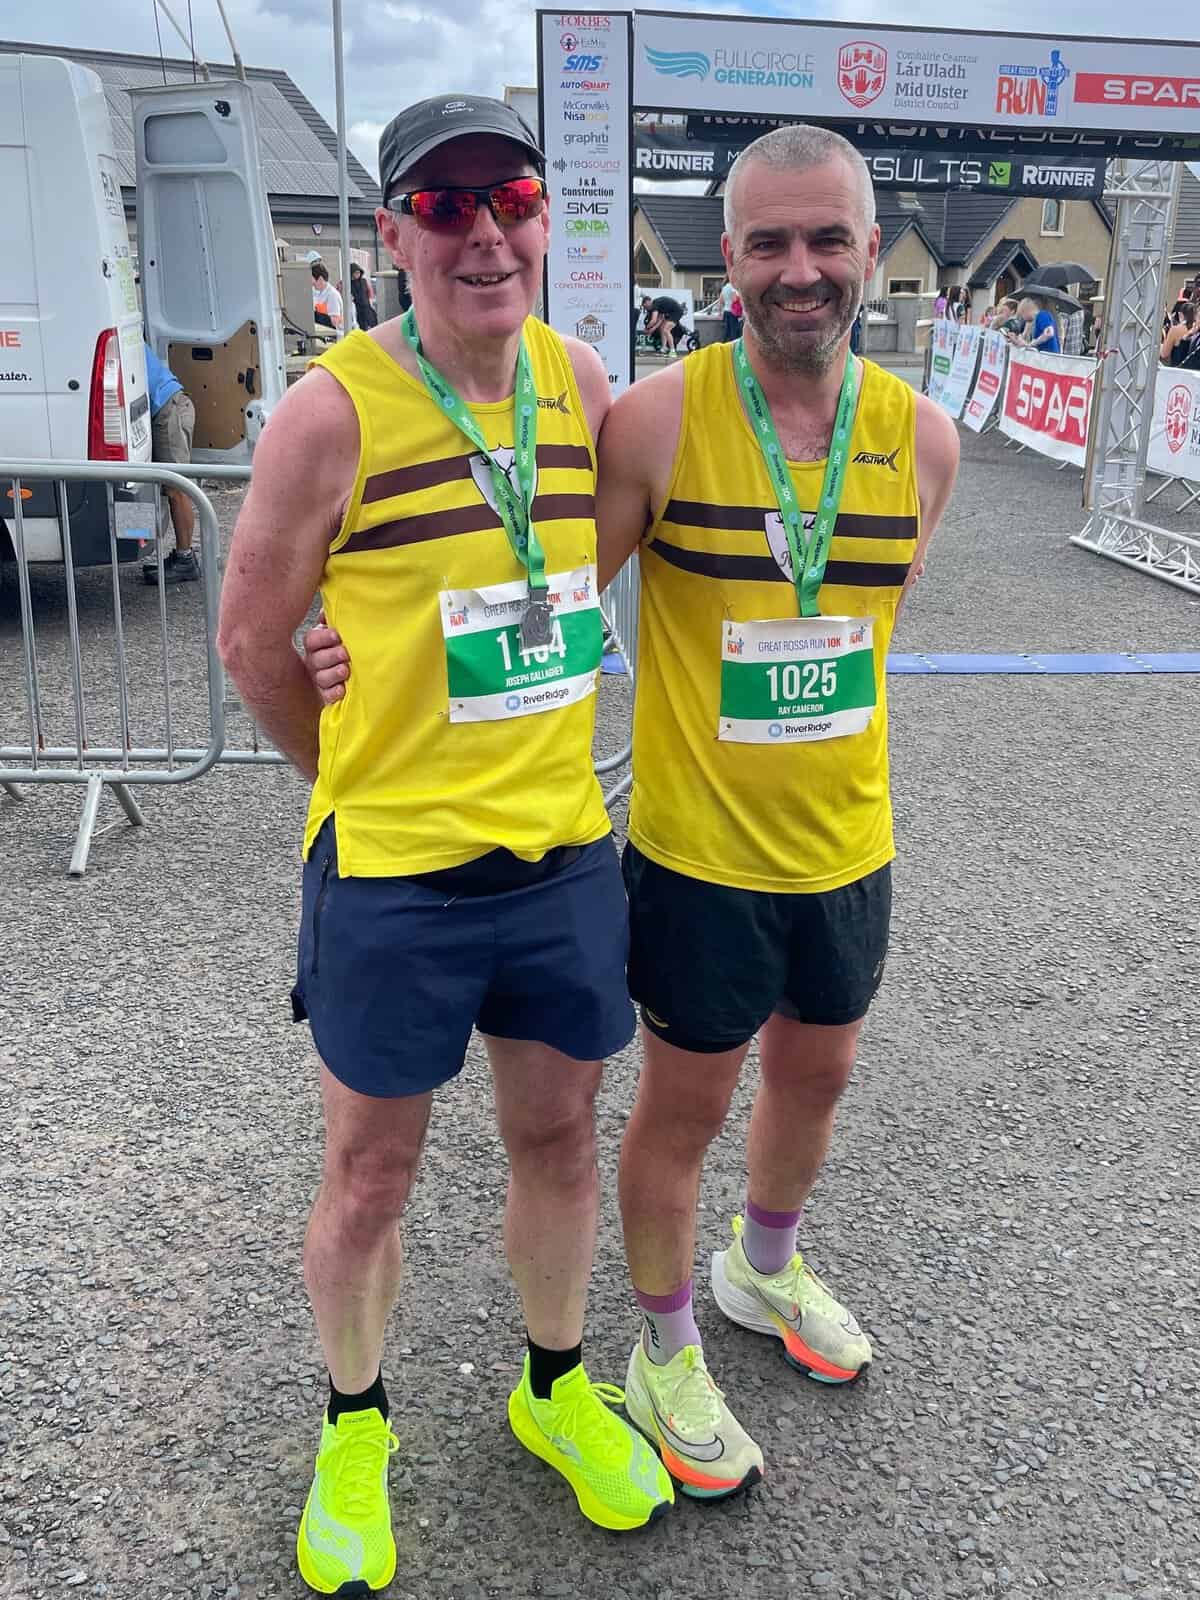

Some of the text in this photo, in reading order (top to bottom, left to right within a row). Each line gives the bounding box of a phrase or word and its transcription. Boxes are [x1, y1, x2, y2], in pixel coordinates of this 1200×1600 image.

[713, 49, 816, 72] FULLCIRCLE
[896, 60, 966, 79] Lár Uladh
[714, 69, 814, 88] GENERATION
[896, 81, 969, 99] Mid Ulster
[996, 77, 1046, 115] RUN
[1104, 80, 1200, 103] SPAR
[894, 99, 959, 110] District Council
[636, 148, 715, 171] RUNNER
[591, 177, 597, 186] A
[1022, 165, 1096, 187] RUNNER
[562, 187, 614, 197] Construction
[564, 202, 611, 215] SMG
[570, 271, 603, 281] CARN
[1016, 373, 1088, 438] SPAR
[758, 637, 841, 652] GREAT ROSSA RUN 10K
[766, 661, 838, 701] 1025
[523, 688, 569, 704] RiverRidge
[778, 704, 824, 715] RAY CAMERON
[785, 722, 832, 734] RiverRidge
